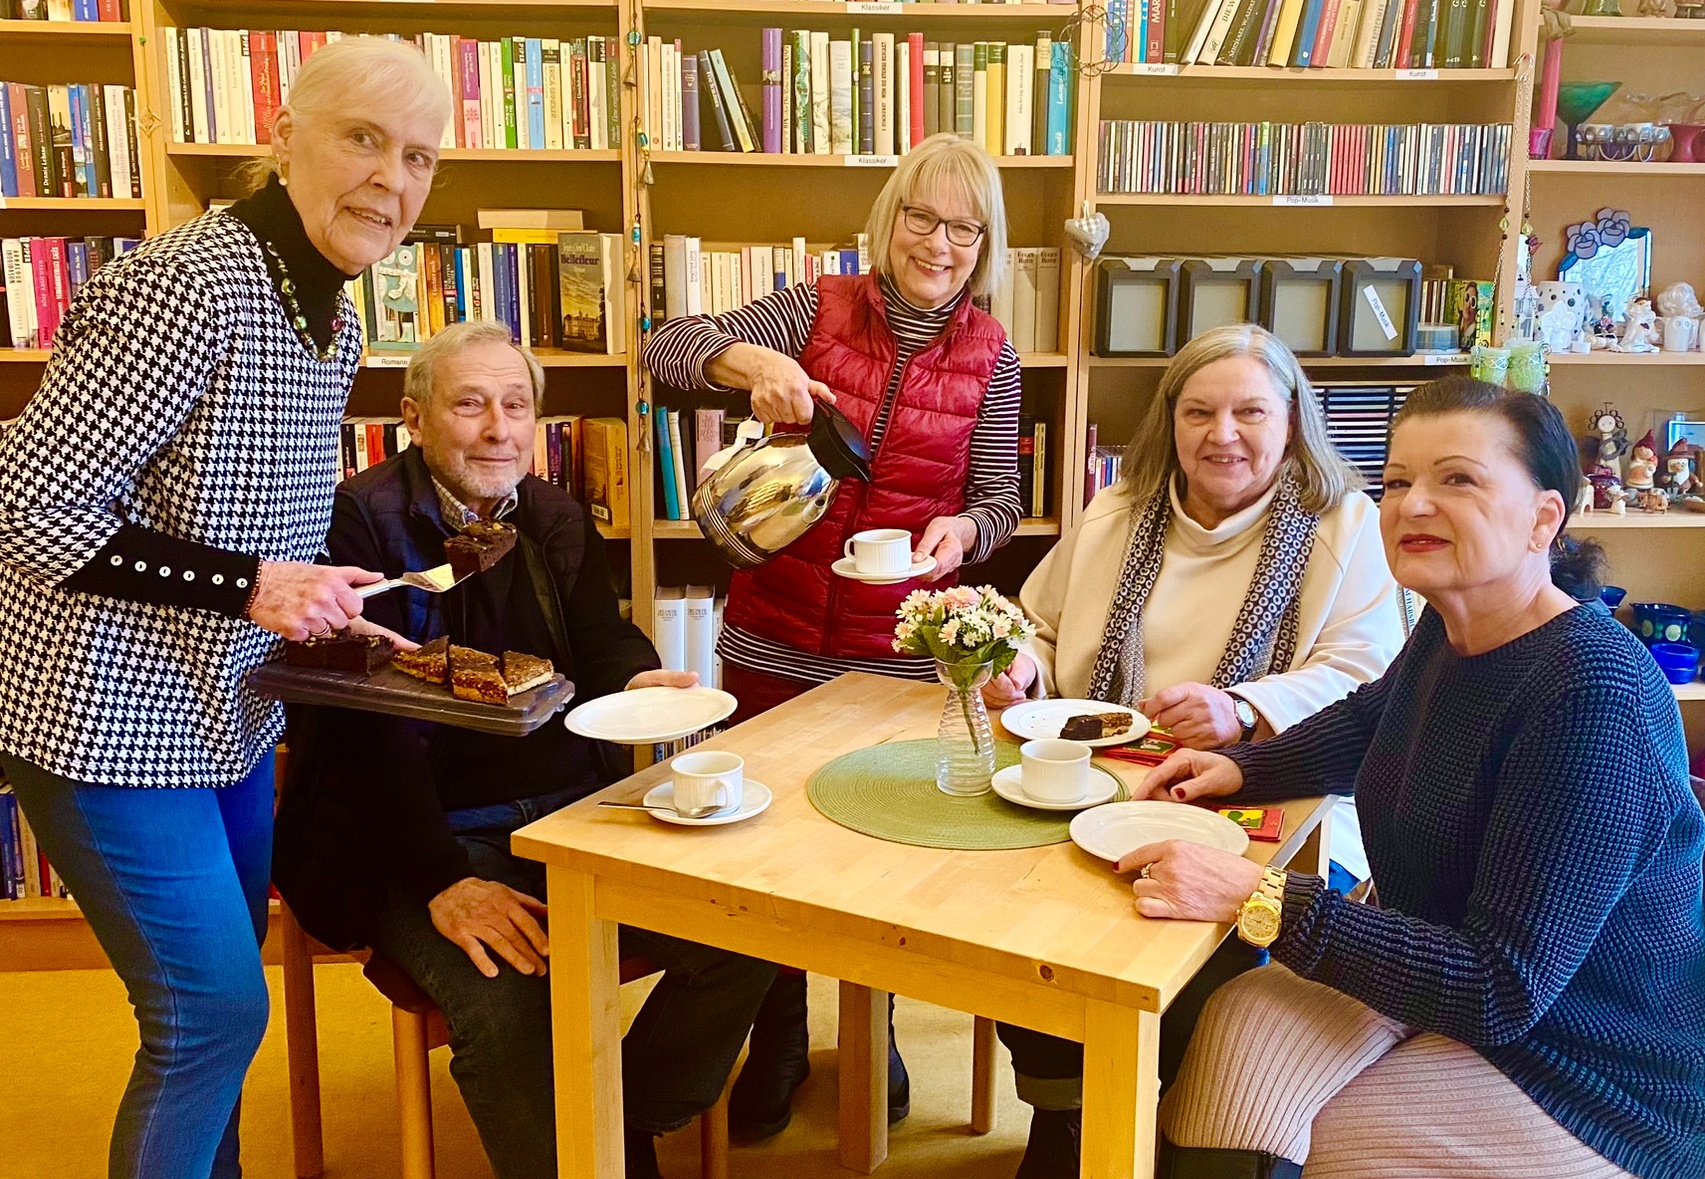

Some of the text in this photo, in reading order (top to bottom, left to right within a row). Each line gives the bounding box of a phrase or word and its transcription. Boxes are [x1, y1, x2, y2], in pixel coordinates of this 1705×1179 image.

[1228, 27, 1244, 58] MICHAEL
[6, 250, 15, 284] INDRIDASON
[13, 250, 22, 283] ARNALDUR
[561, 254, 599, 265] Bellefleur
[1372, 298, 1390, 328] Pop-Musik
